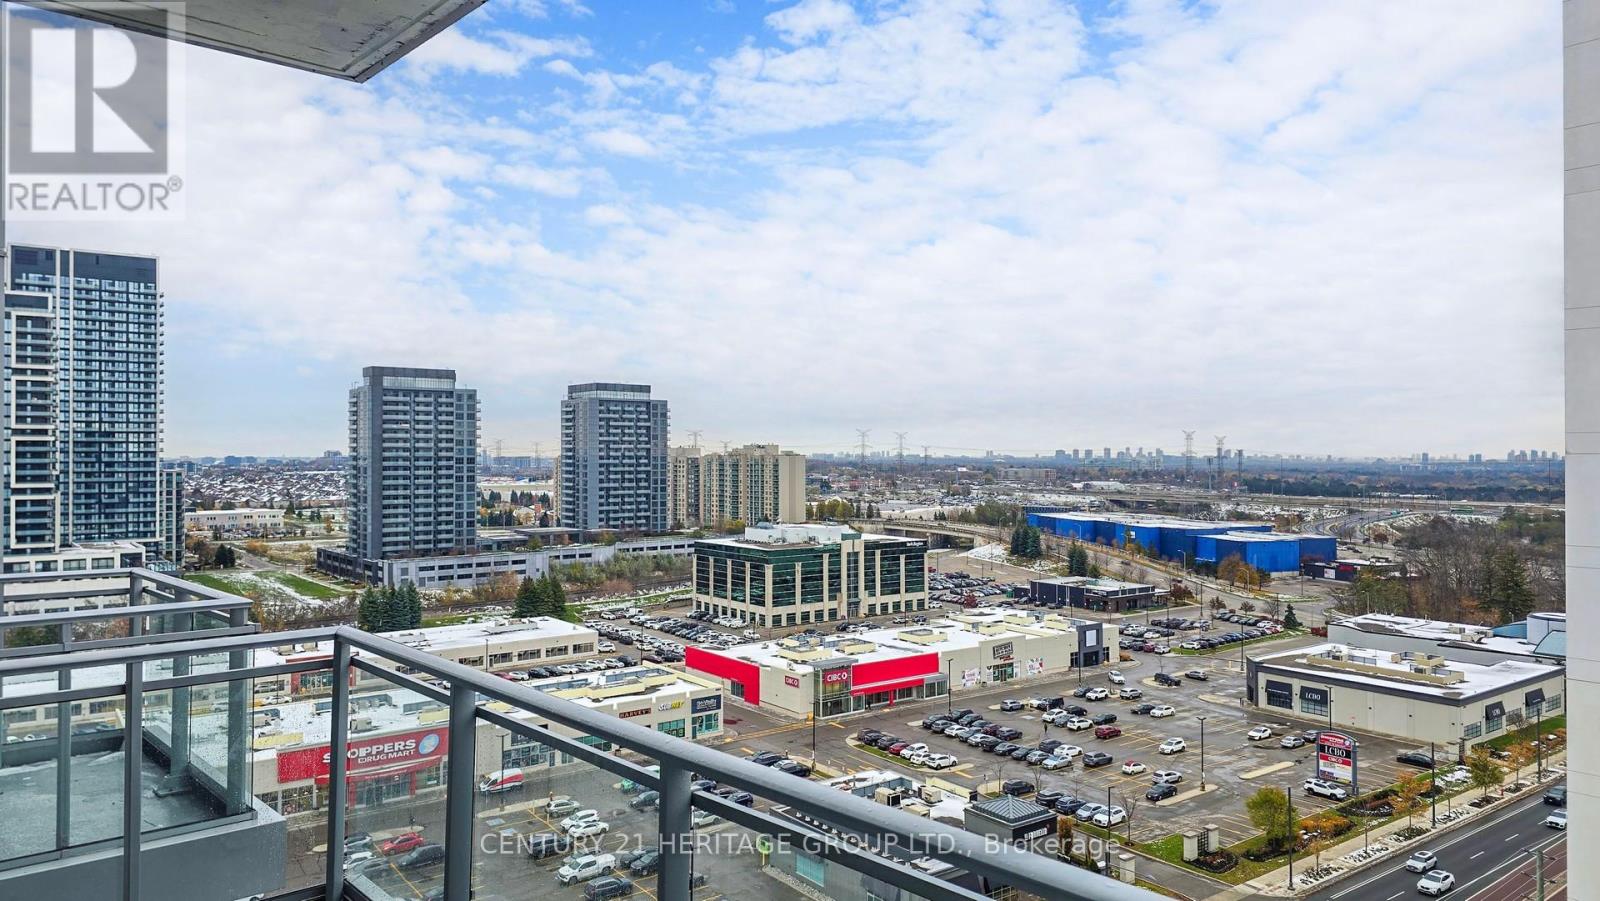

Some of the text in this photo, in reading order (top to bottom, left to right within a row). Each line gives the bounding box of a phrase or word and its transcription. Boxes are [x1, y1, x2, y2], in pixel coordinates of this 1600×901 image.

[827, 673, 841, 682] CIBC
[323, 740, 416, 762] SOPPERS
[358, 749, 415, 764] DRUG MART
[1324, 745, 1346, 758] LCBO
